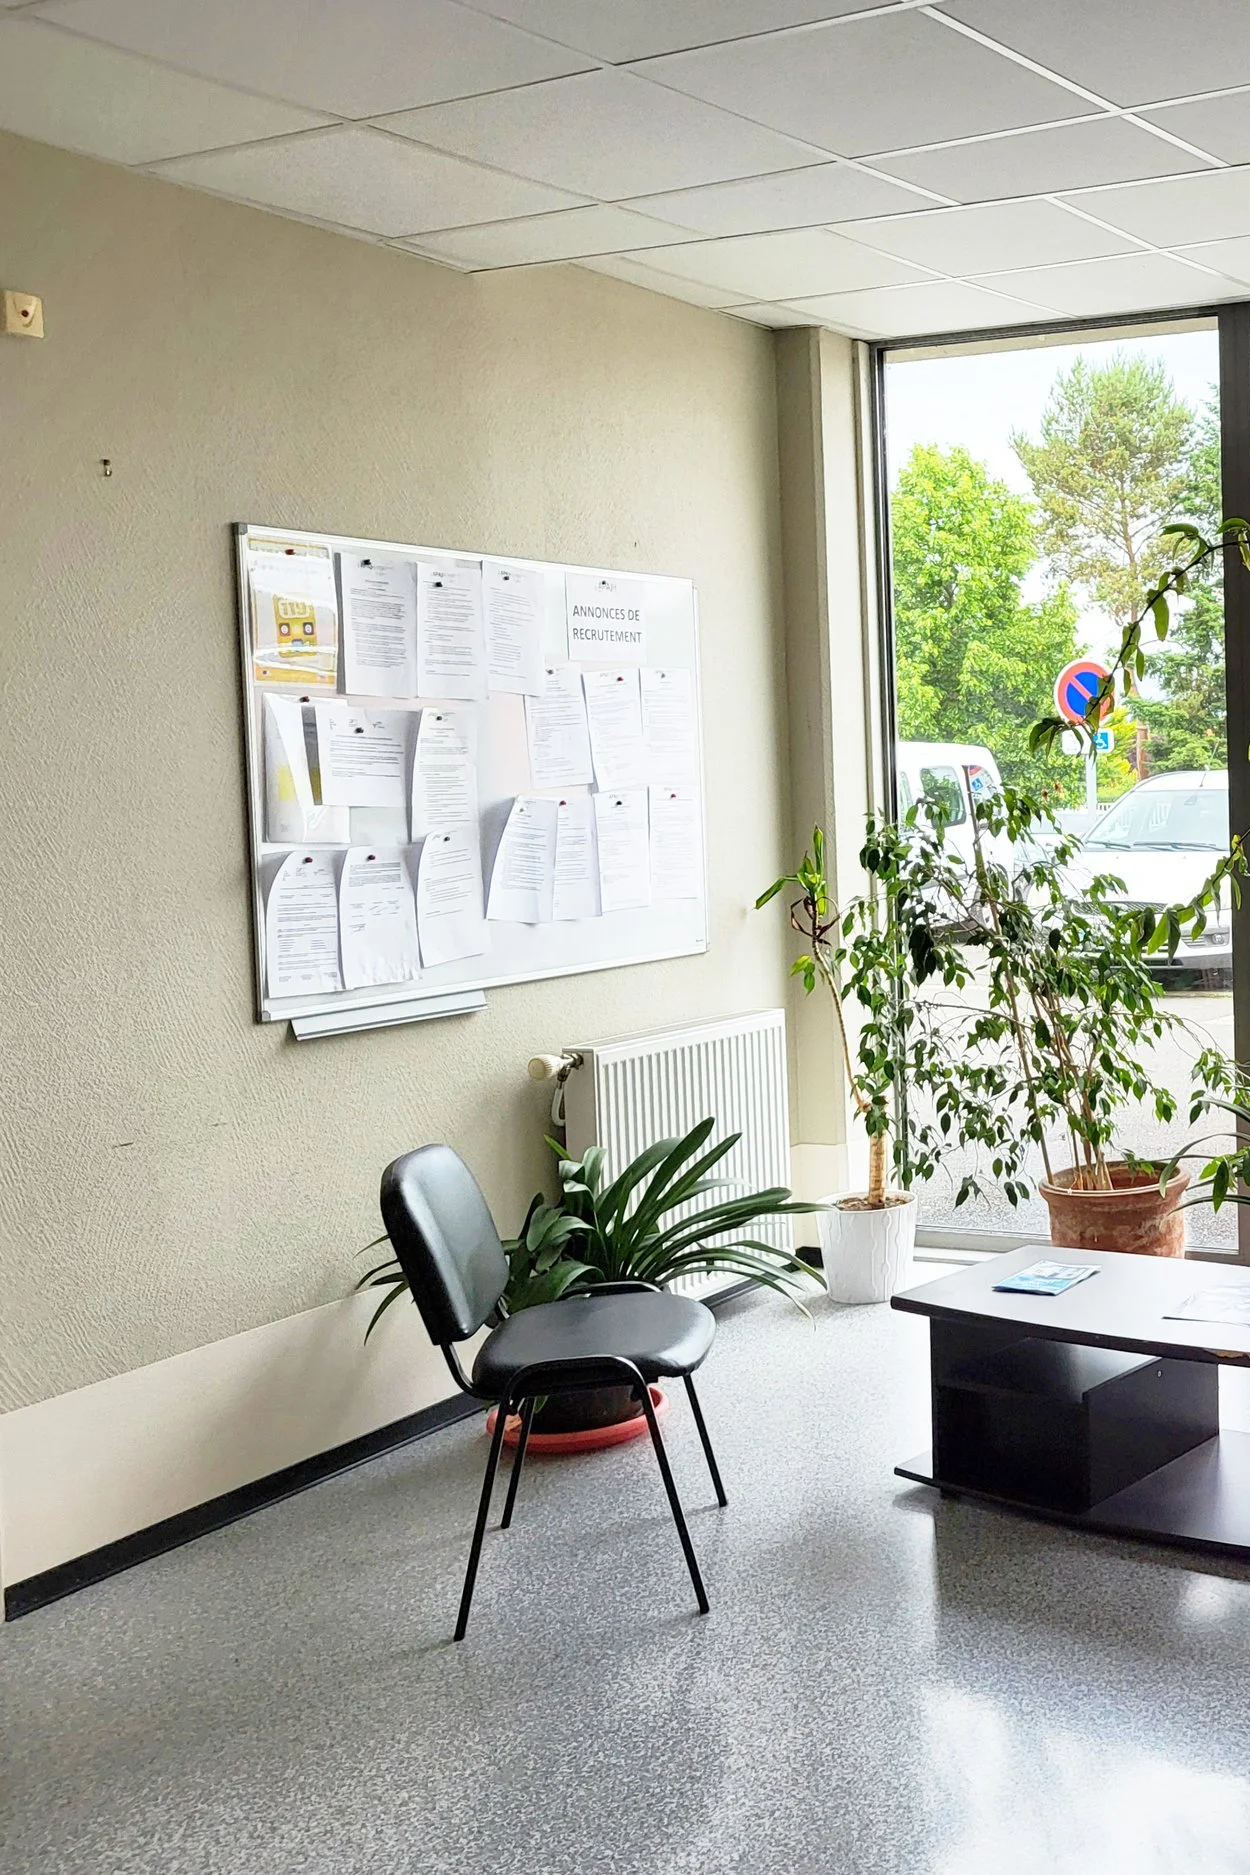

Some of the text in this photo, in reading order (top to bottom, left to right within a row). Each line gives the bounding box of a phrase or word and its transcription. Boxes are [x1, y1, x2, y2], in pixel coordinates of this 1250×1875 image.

[572, 605, 640, 621] ANNONCES DE
[572, 627, 642, 643] RECRUTEMENT
